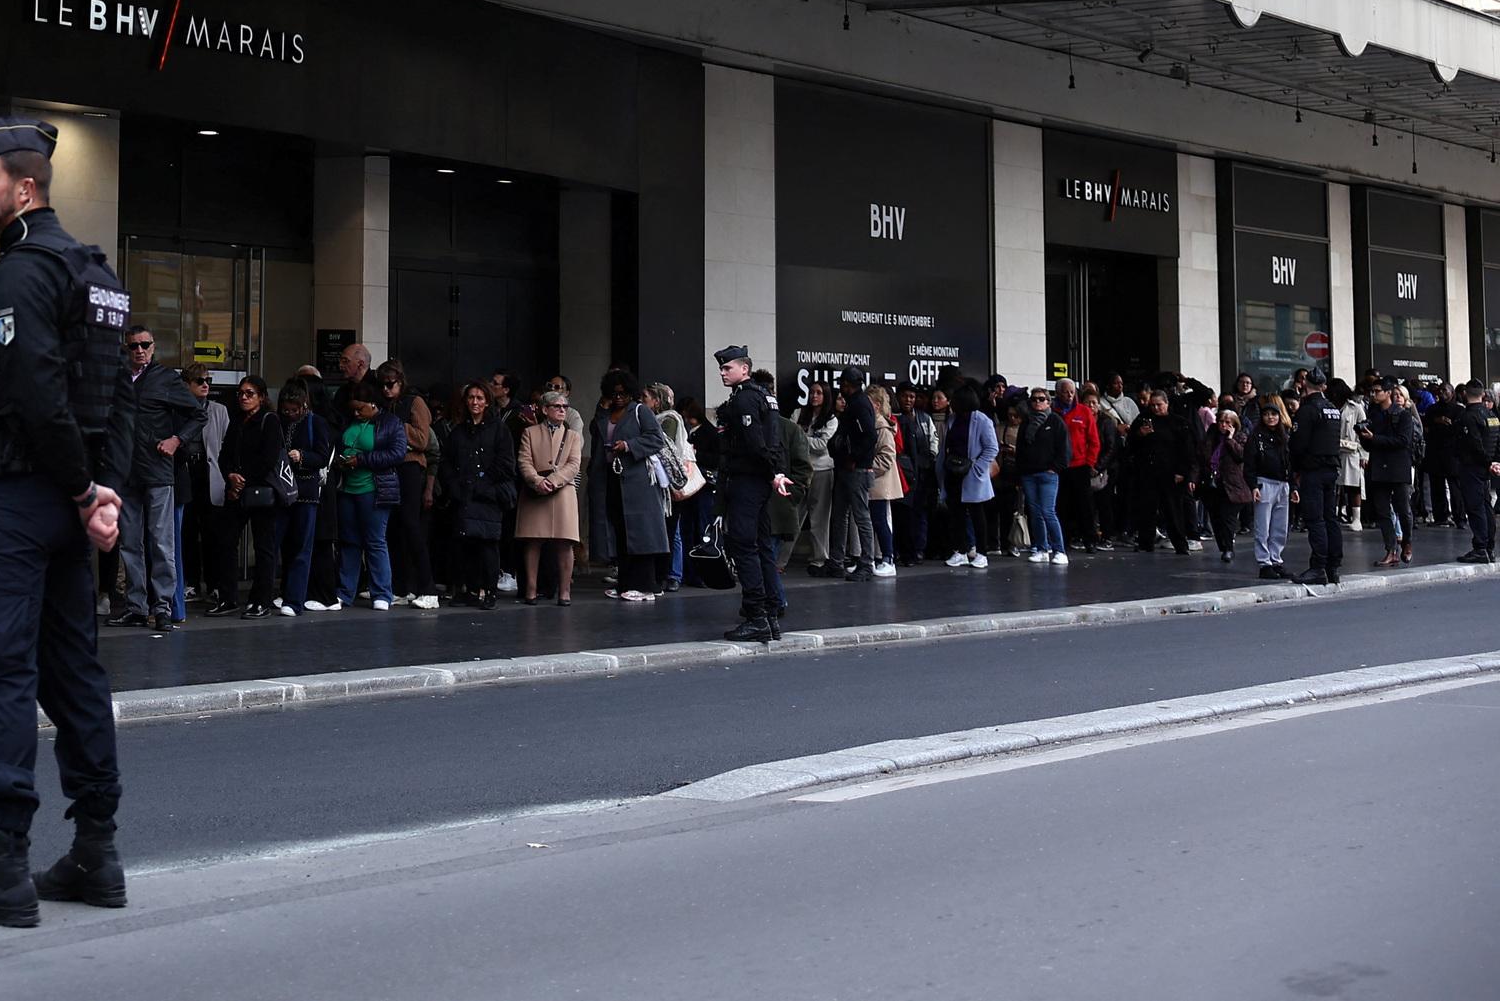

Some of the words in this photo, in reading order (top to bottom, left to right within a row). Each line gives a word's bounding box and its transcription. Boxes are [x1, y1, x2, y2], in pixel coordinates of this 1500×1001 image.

[185, 15, 304, 64] MARAIS
[1066, 178, 1081, 200] LE
[1084, 181, 1112, 204] BHV
[1121, 187, 1170, 212] MARAIS
[870, 203, 906, 241] BHV
[1272, 256, 1297, 286] BHV
[1397, 272, 1418, 300] BHV
[96, 308, 104, 322] B
[841, 310, 883, 324] UNIQUEMENT
[884, 313, 892, 325] LE
[898, 315, 931, 328] NOVEMBRE
[797, 351, 811, 363] TON
[811, 351, 843, 365] MONTANT
[843, 353, 871, 366] D'ACHAT
[908, 345, 916, 356] LE
[933, 346, 959, 358] MONTANT
